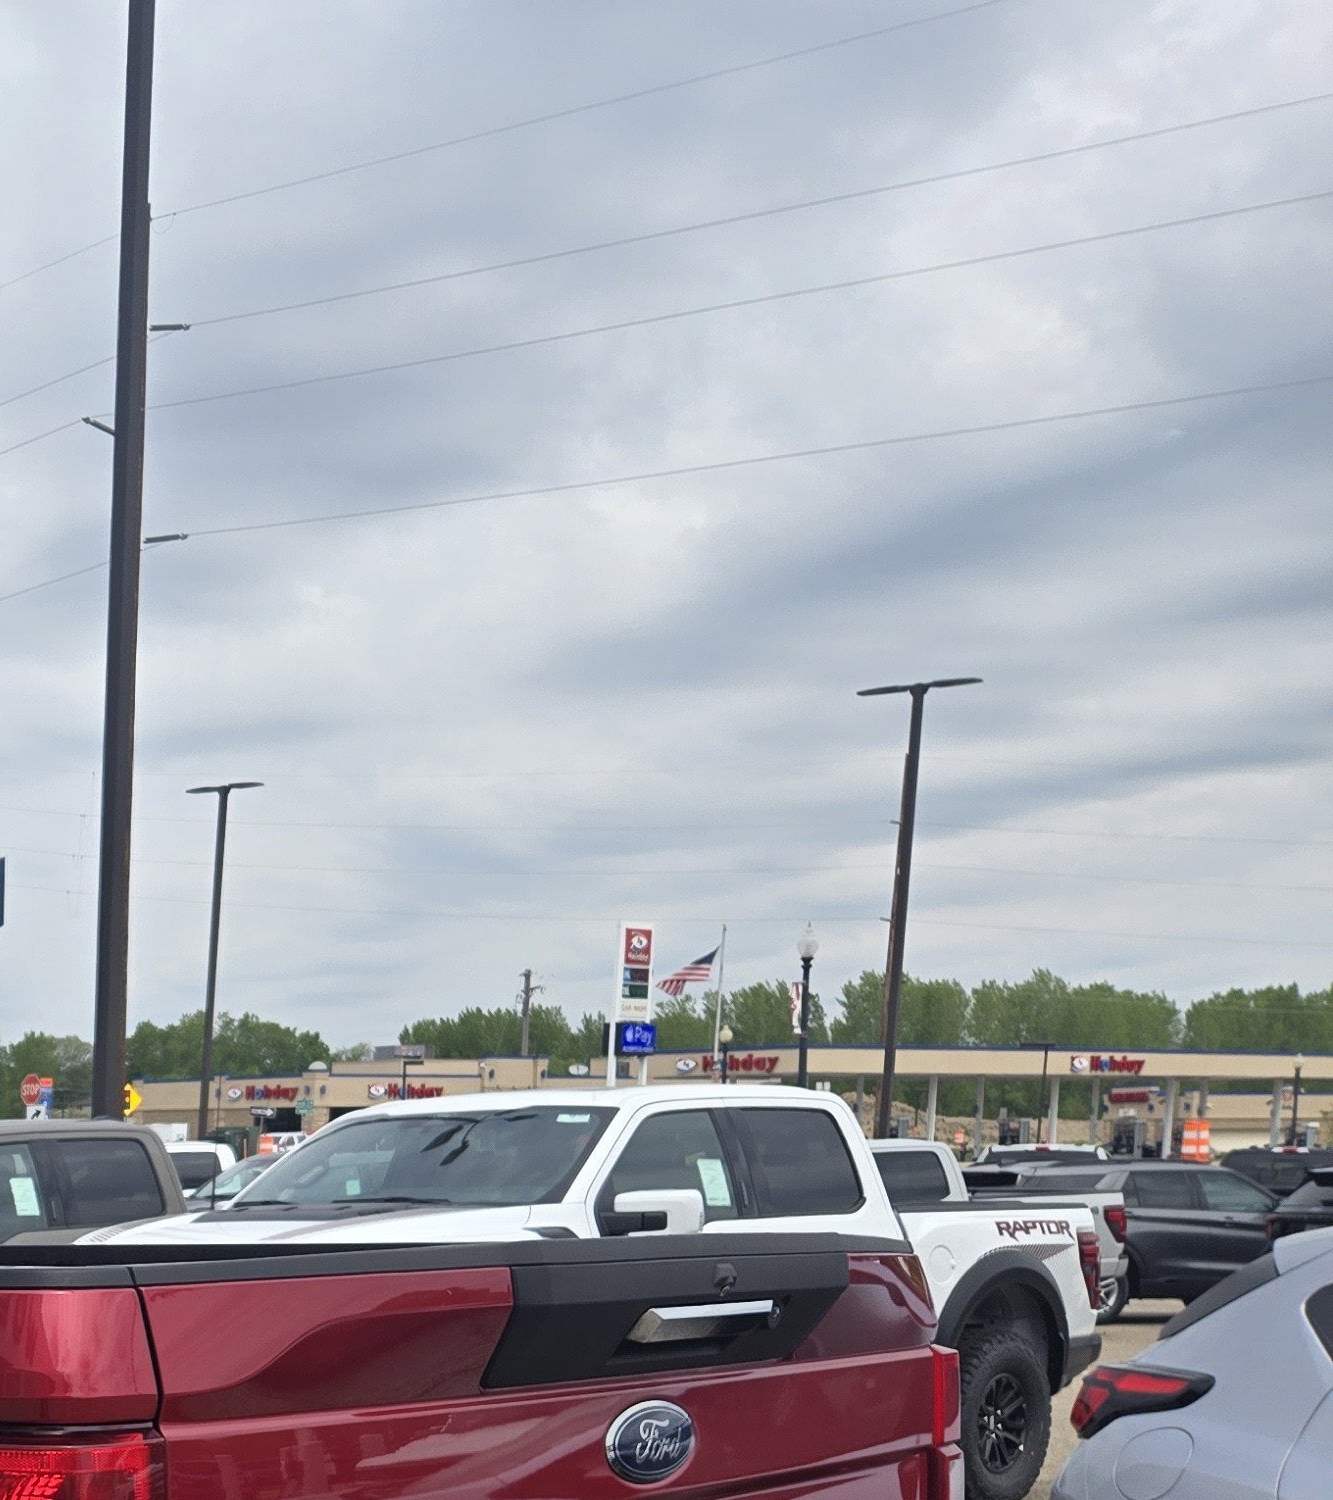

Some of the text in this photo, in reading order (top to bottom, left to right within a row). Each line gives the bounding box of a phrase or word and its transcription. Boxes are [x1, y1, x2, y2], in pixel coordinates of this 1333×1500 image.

[635, 1025, 653, 1046] Pay
[22, 1083, 40, 1096] STOP
[995, 1219, 1076, 1242] RAPTOR
[635, 1418, 683, 1465] Ford
